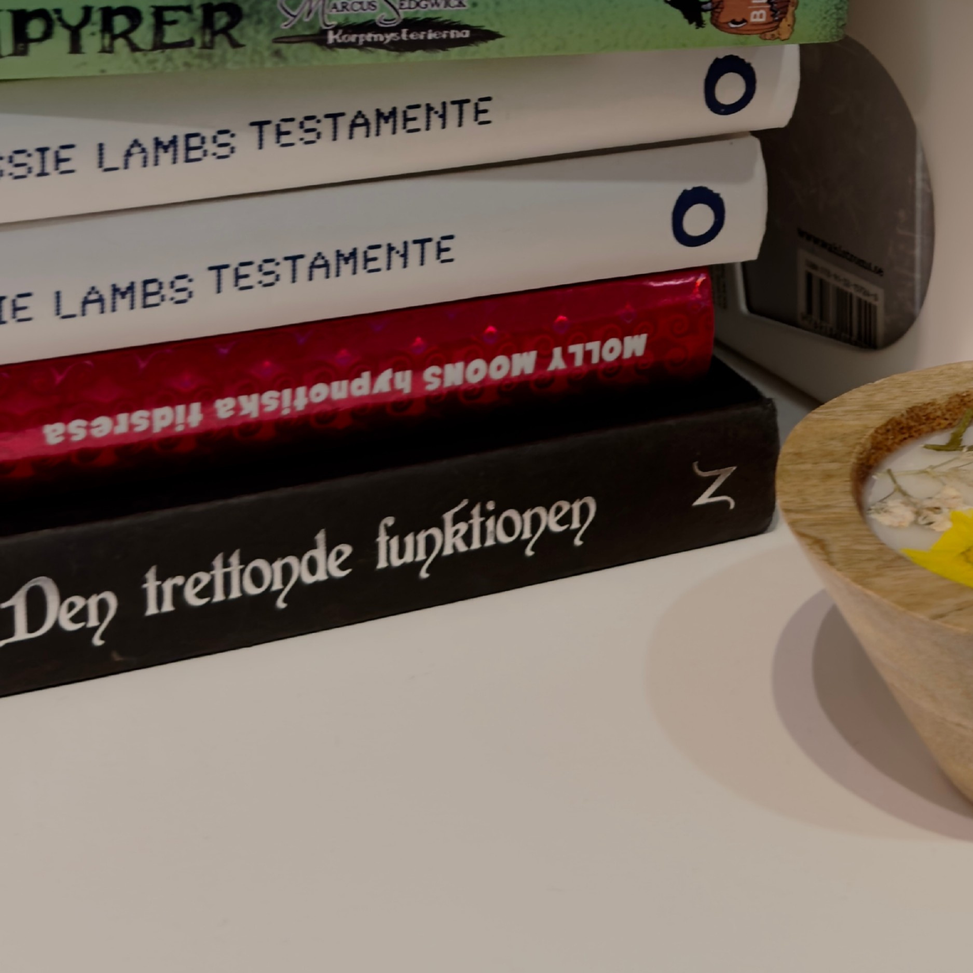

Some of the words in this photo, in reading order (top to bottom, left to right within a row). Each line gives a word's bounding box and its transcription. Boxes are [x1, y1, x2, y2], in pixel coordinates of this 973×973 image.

[0, 1, 245, 59] PYRER
[327, 26, 470, 46] Korpmysterierna
[0, 144, 76, 179] SIE
[99, 129, 236, 172] LAMBS
[250, 96, 492, 149] TESTAMENTE
[55, 275, 193, 319] LAMBS
[208, 235, 455, 293] TESTAMENTE
[424, 350, 538, 391] MOONS
[547, 333, 648, 372] MOLLY
[214, 365, 412, 420] hypnotiska
[42, 402, 203, 445] tidsresa
[0, 576, 118, 646] Den
[142, 528, 353, 616] trettonde
[375, 495, 597, 579] funktionen
